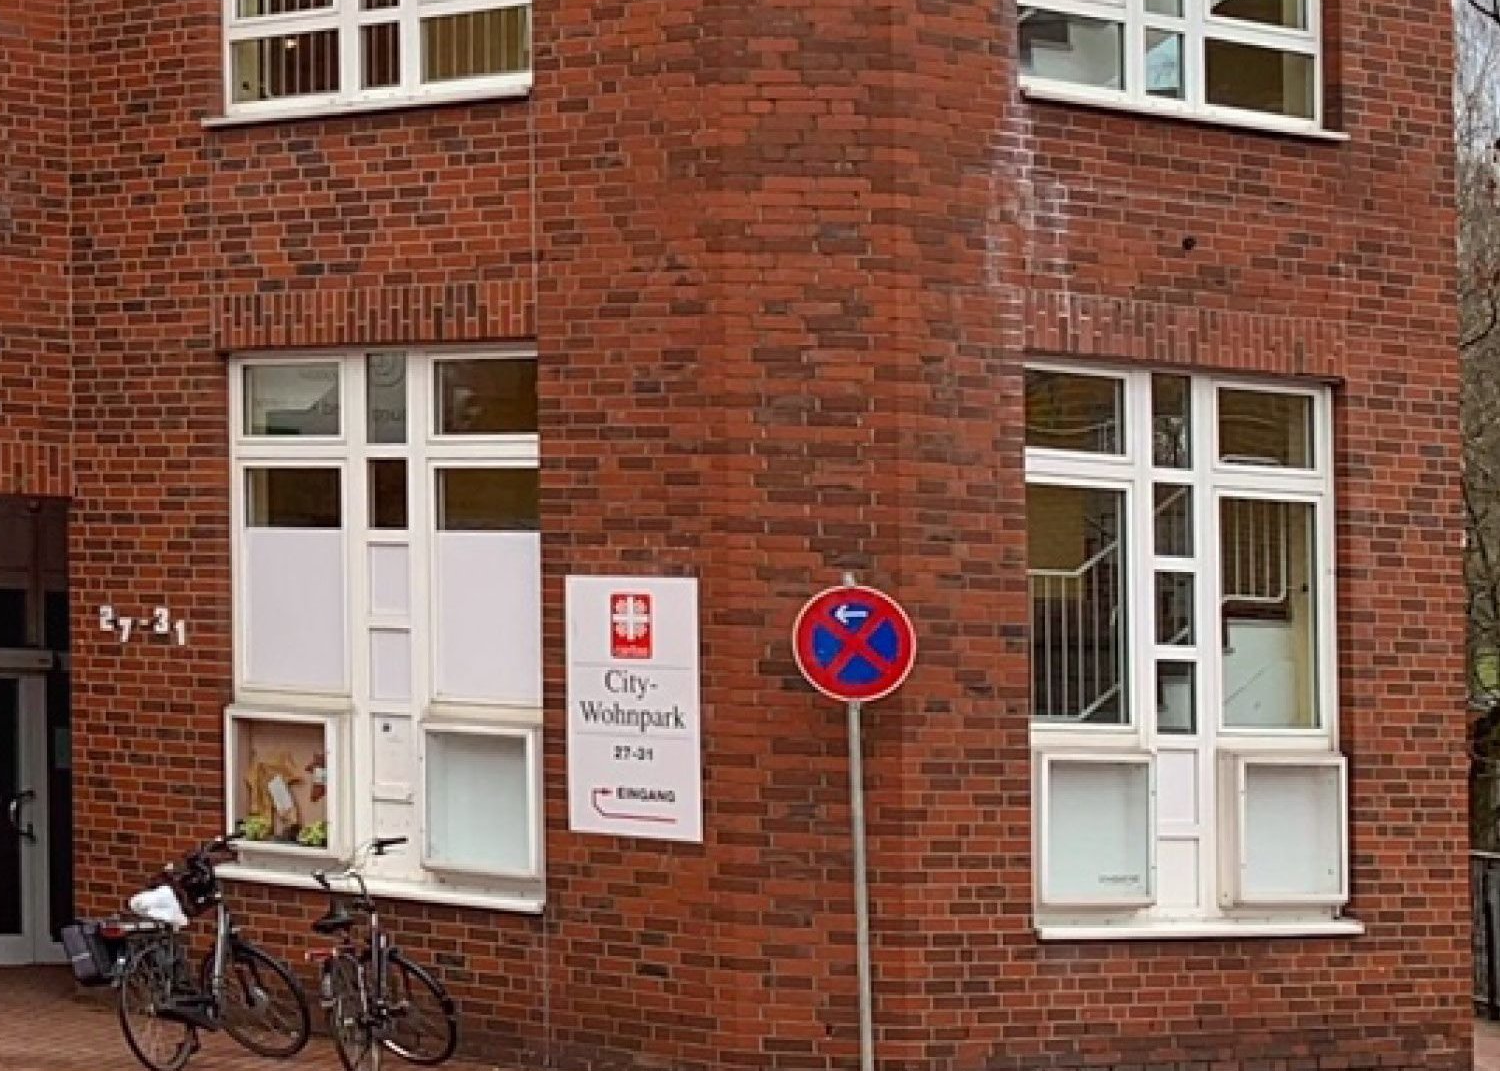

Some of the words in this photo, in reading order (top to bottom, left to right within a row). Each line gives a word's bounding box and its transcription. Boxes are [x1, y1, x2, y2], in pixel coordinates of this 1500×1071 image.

[100, 605, 185, 646] 27-31
[604, 669, 658, 701] City-
[579, 700, 686, 733] Wohnpark
[616, 787, 676, 803] EINGANG
